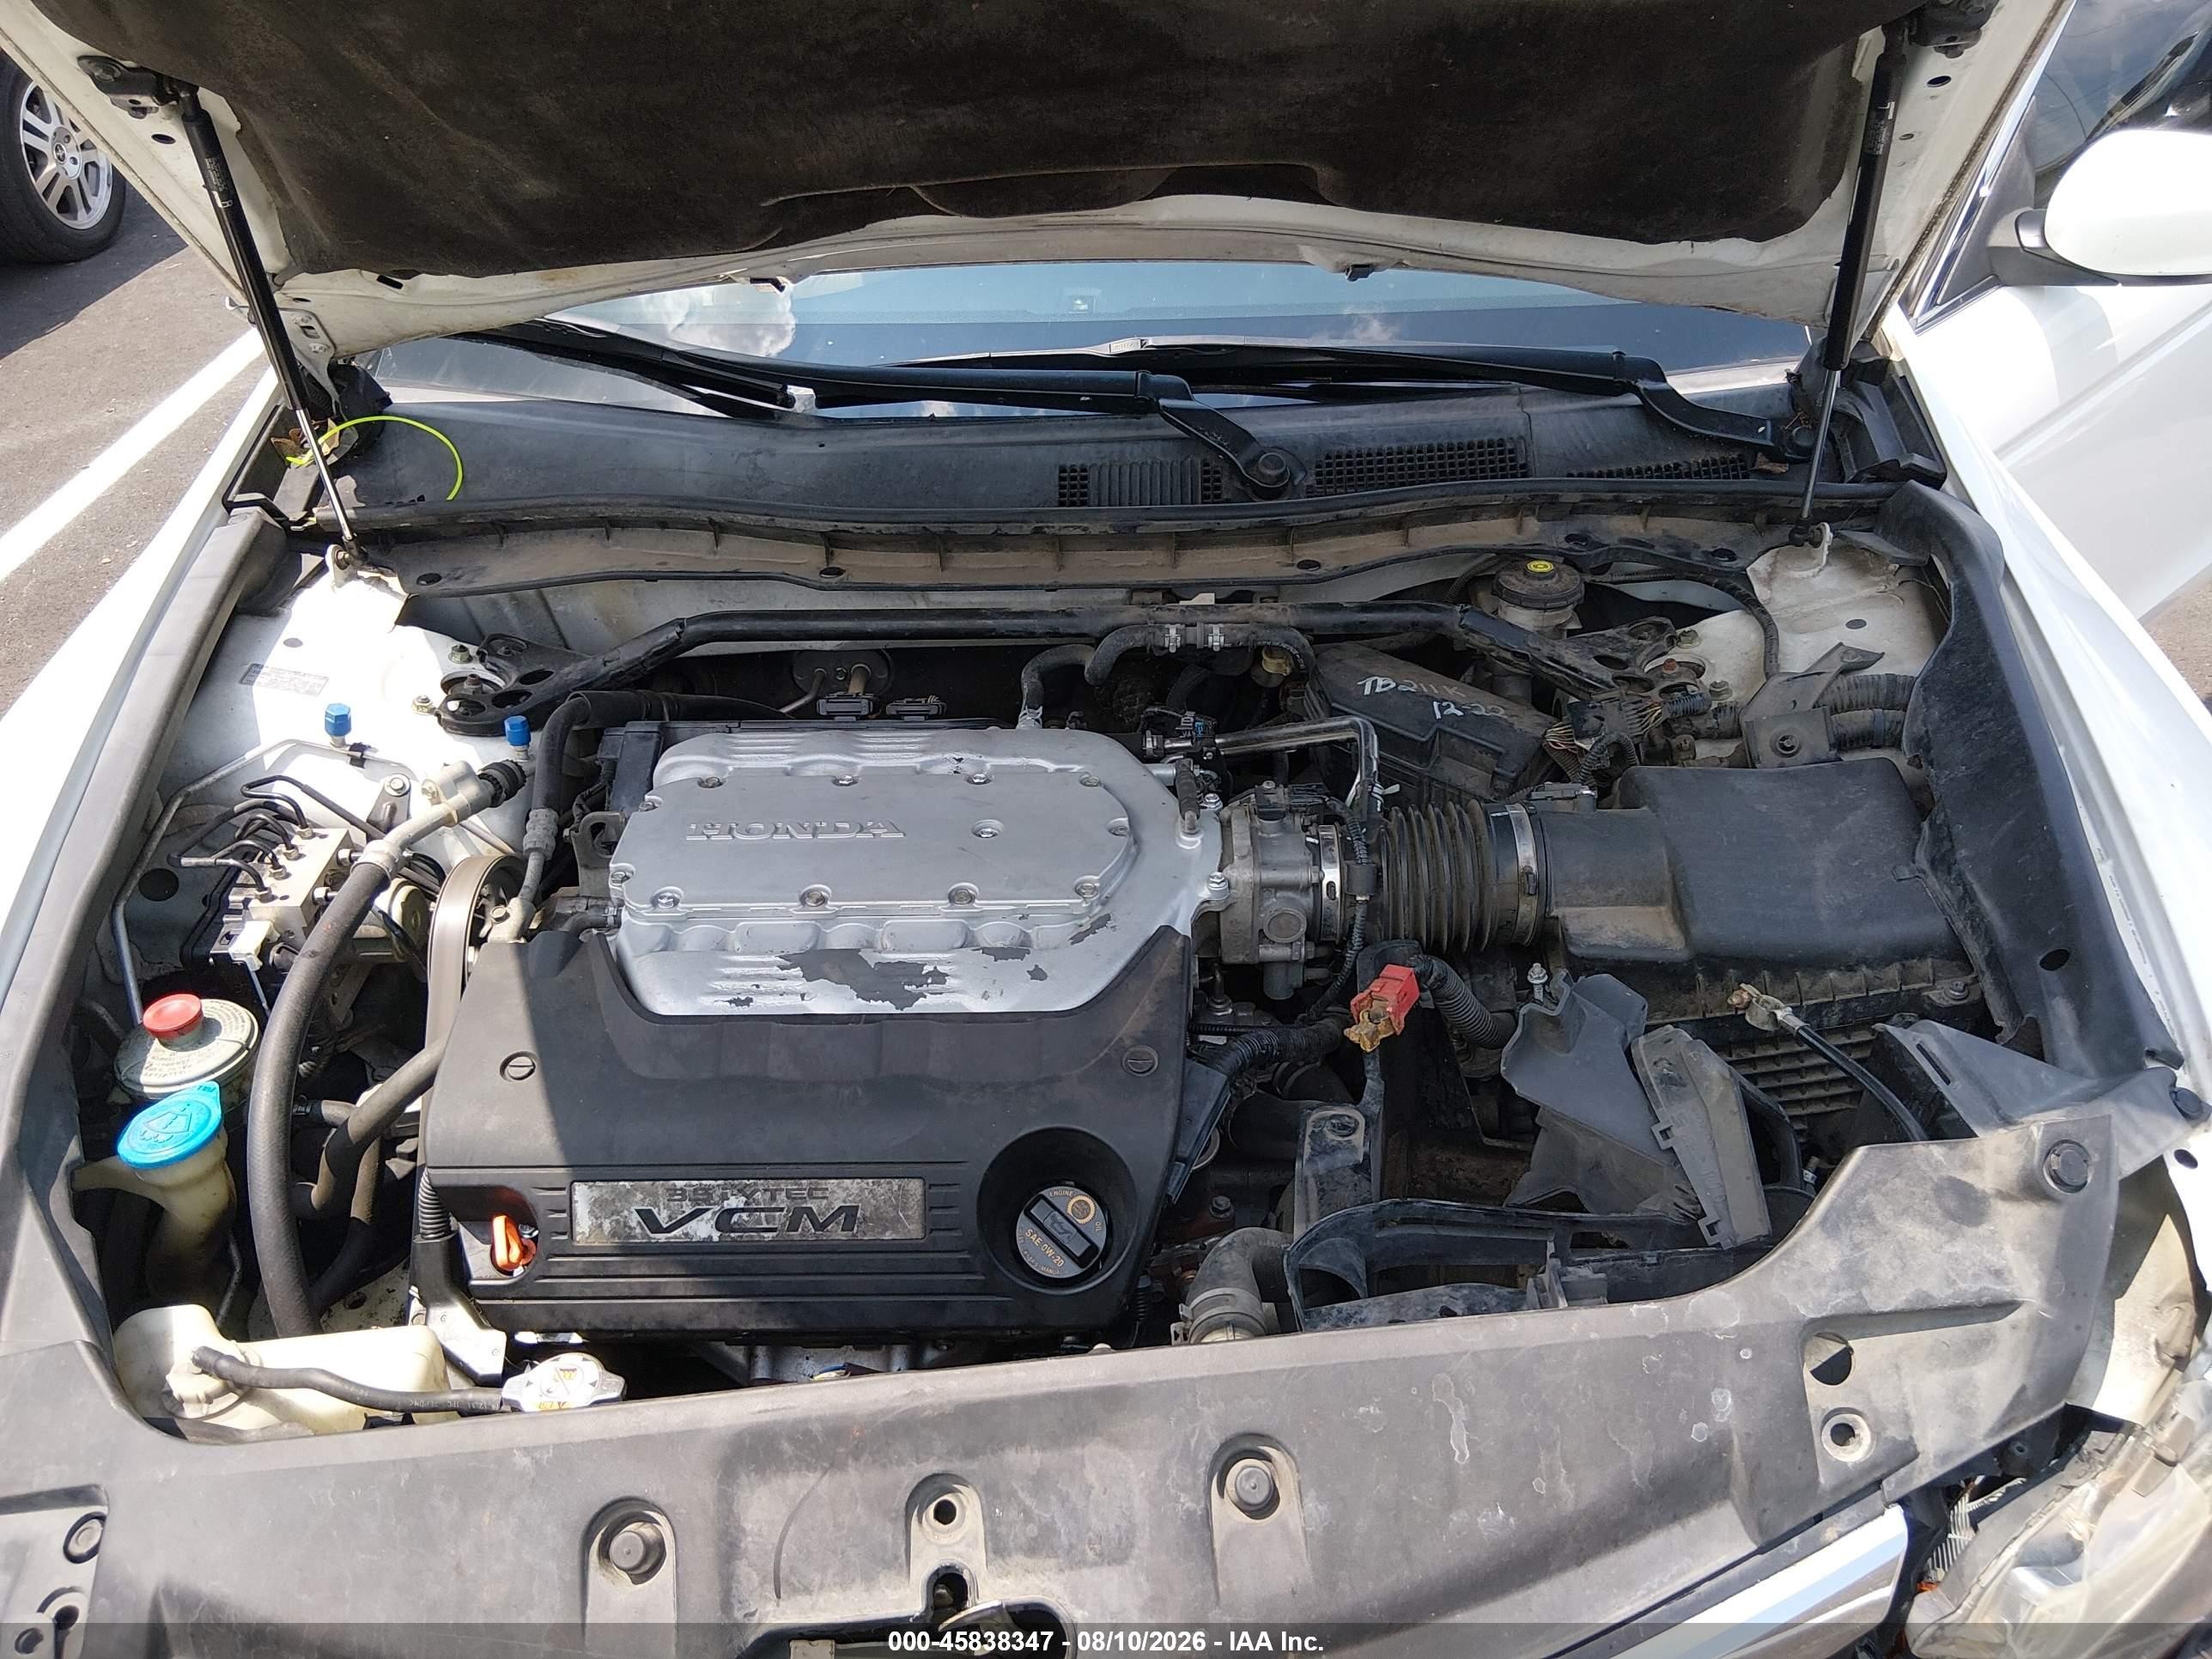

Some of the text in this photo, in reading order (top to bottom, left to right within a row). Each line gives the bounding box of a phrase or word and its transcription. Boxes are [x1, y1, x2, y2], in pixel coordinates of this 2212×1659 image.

[686, 821, 907, 841] HONDA
[634, 1204, 860, 1235] VCM
[1025, 1229, 1065, 1267] SAE 0W-20
